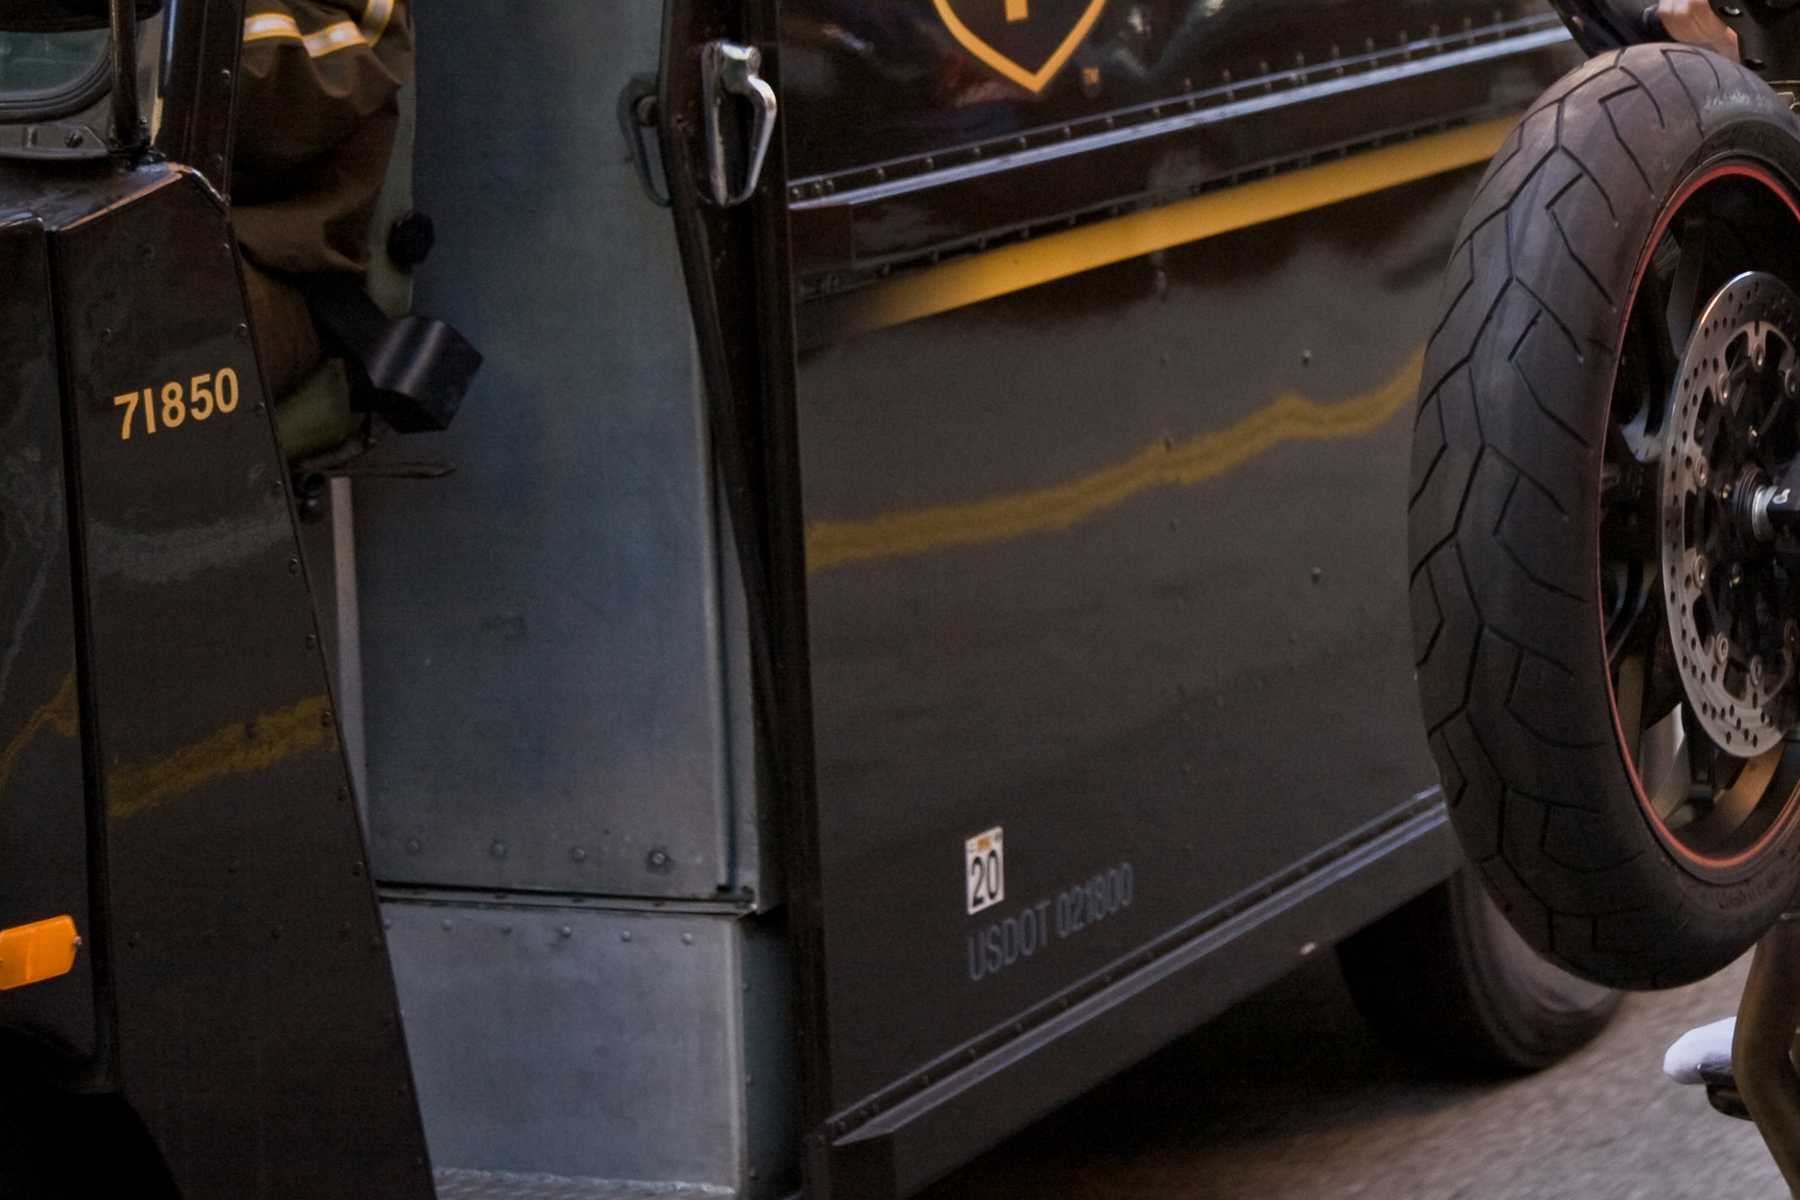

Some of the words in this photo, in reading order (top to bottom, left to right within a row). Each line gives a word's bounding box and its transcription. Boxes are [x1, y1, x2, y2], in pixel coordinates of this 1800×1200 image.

[113, 367, 239, 440] 71850
[971, 849, 1000, 908] 20
[968, 901, 1051, 980] USDOT
[1055, 862, 1133, 936] 021800
